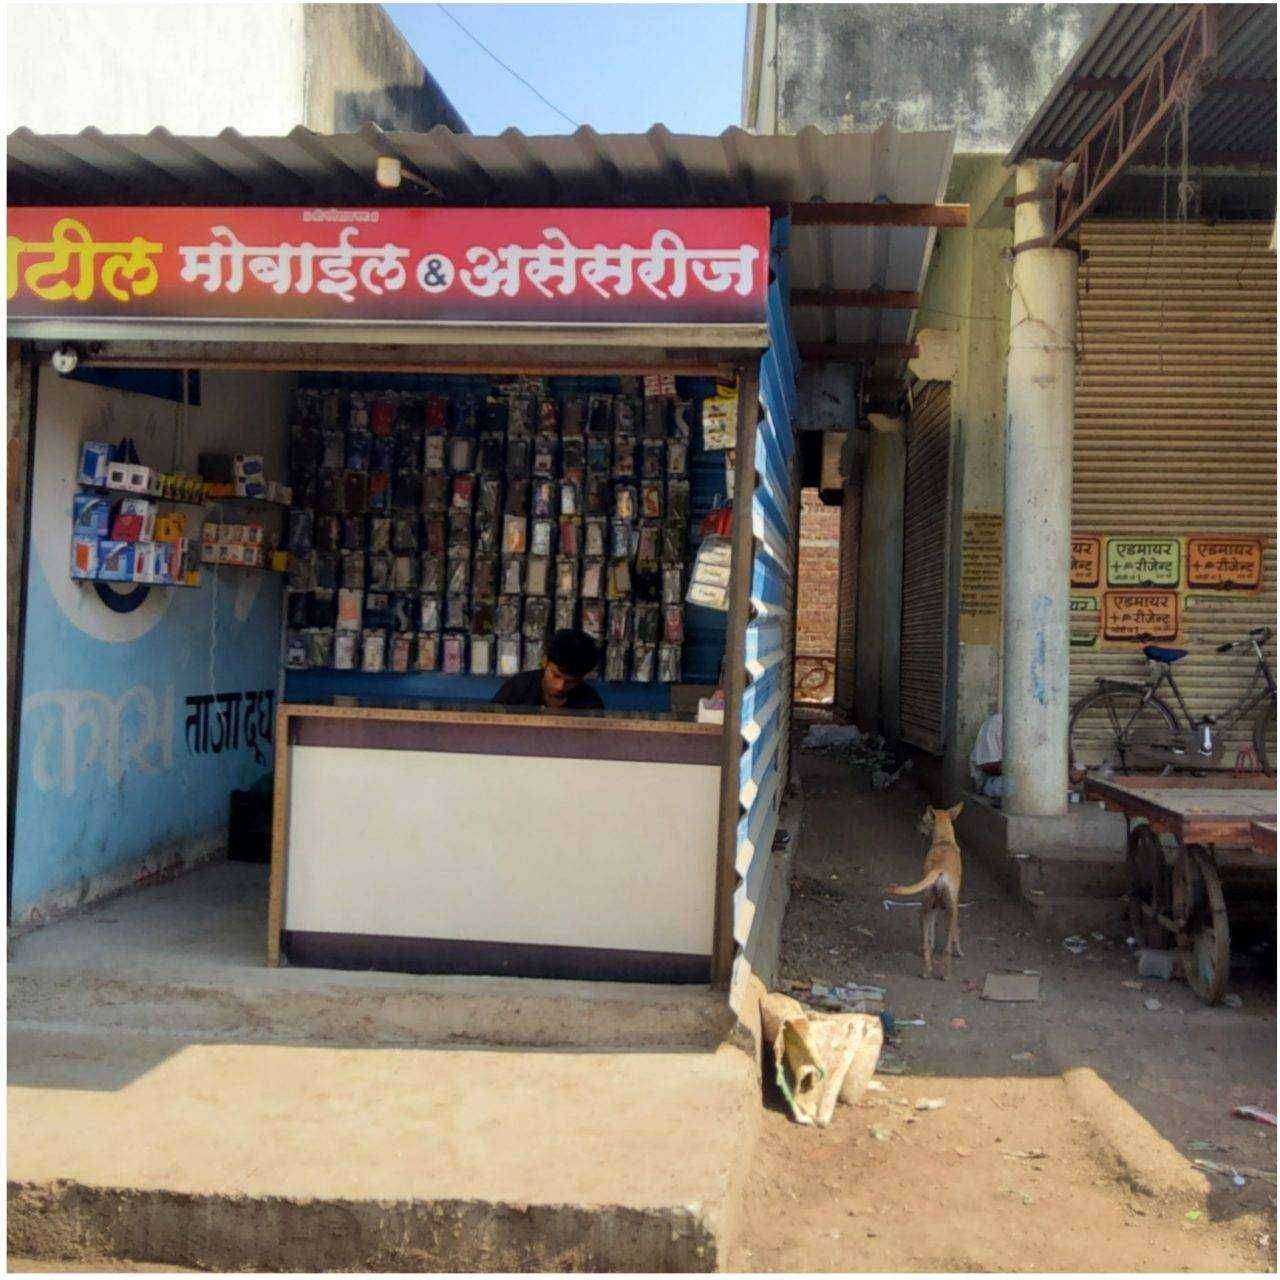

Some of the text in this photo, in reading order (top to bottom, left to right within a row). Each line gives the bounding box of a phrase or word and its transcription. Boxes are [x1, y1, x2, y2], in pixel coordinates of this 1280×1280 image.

[179, 225, 410, 303] मोबाईल
[420, 256, 451, 291] &
[460, 227, 759, 300] असेसरीज
[1116, 542, 1172, 558] एडमायर
[1197, 543, 1253, 558] एडमायर
[185, 691, 242, 754] ताजा
